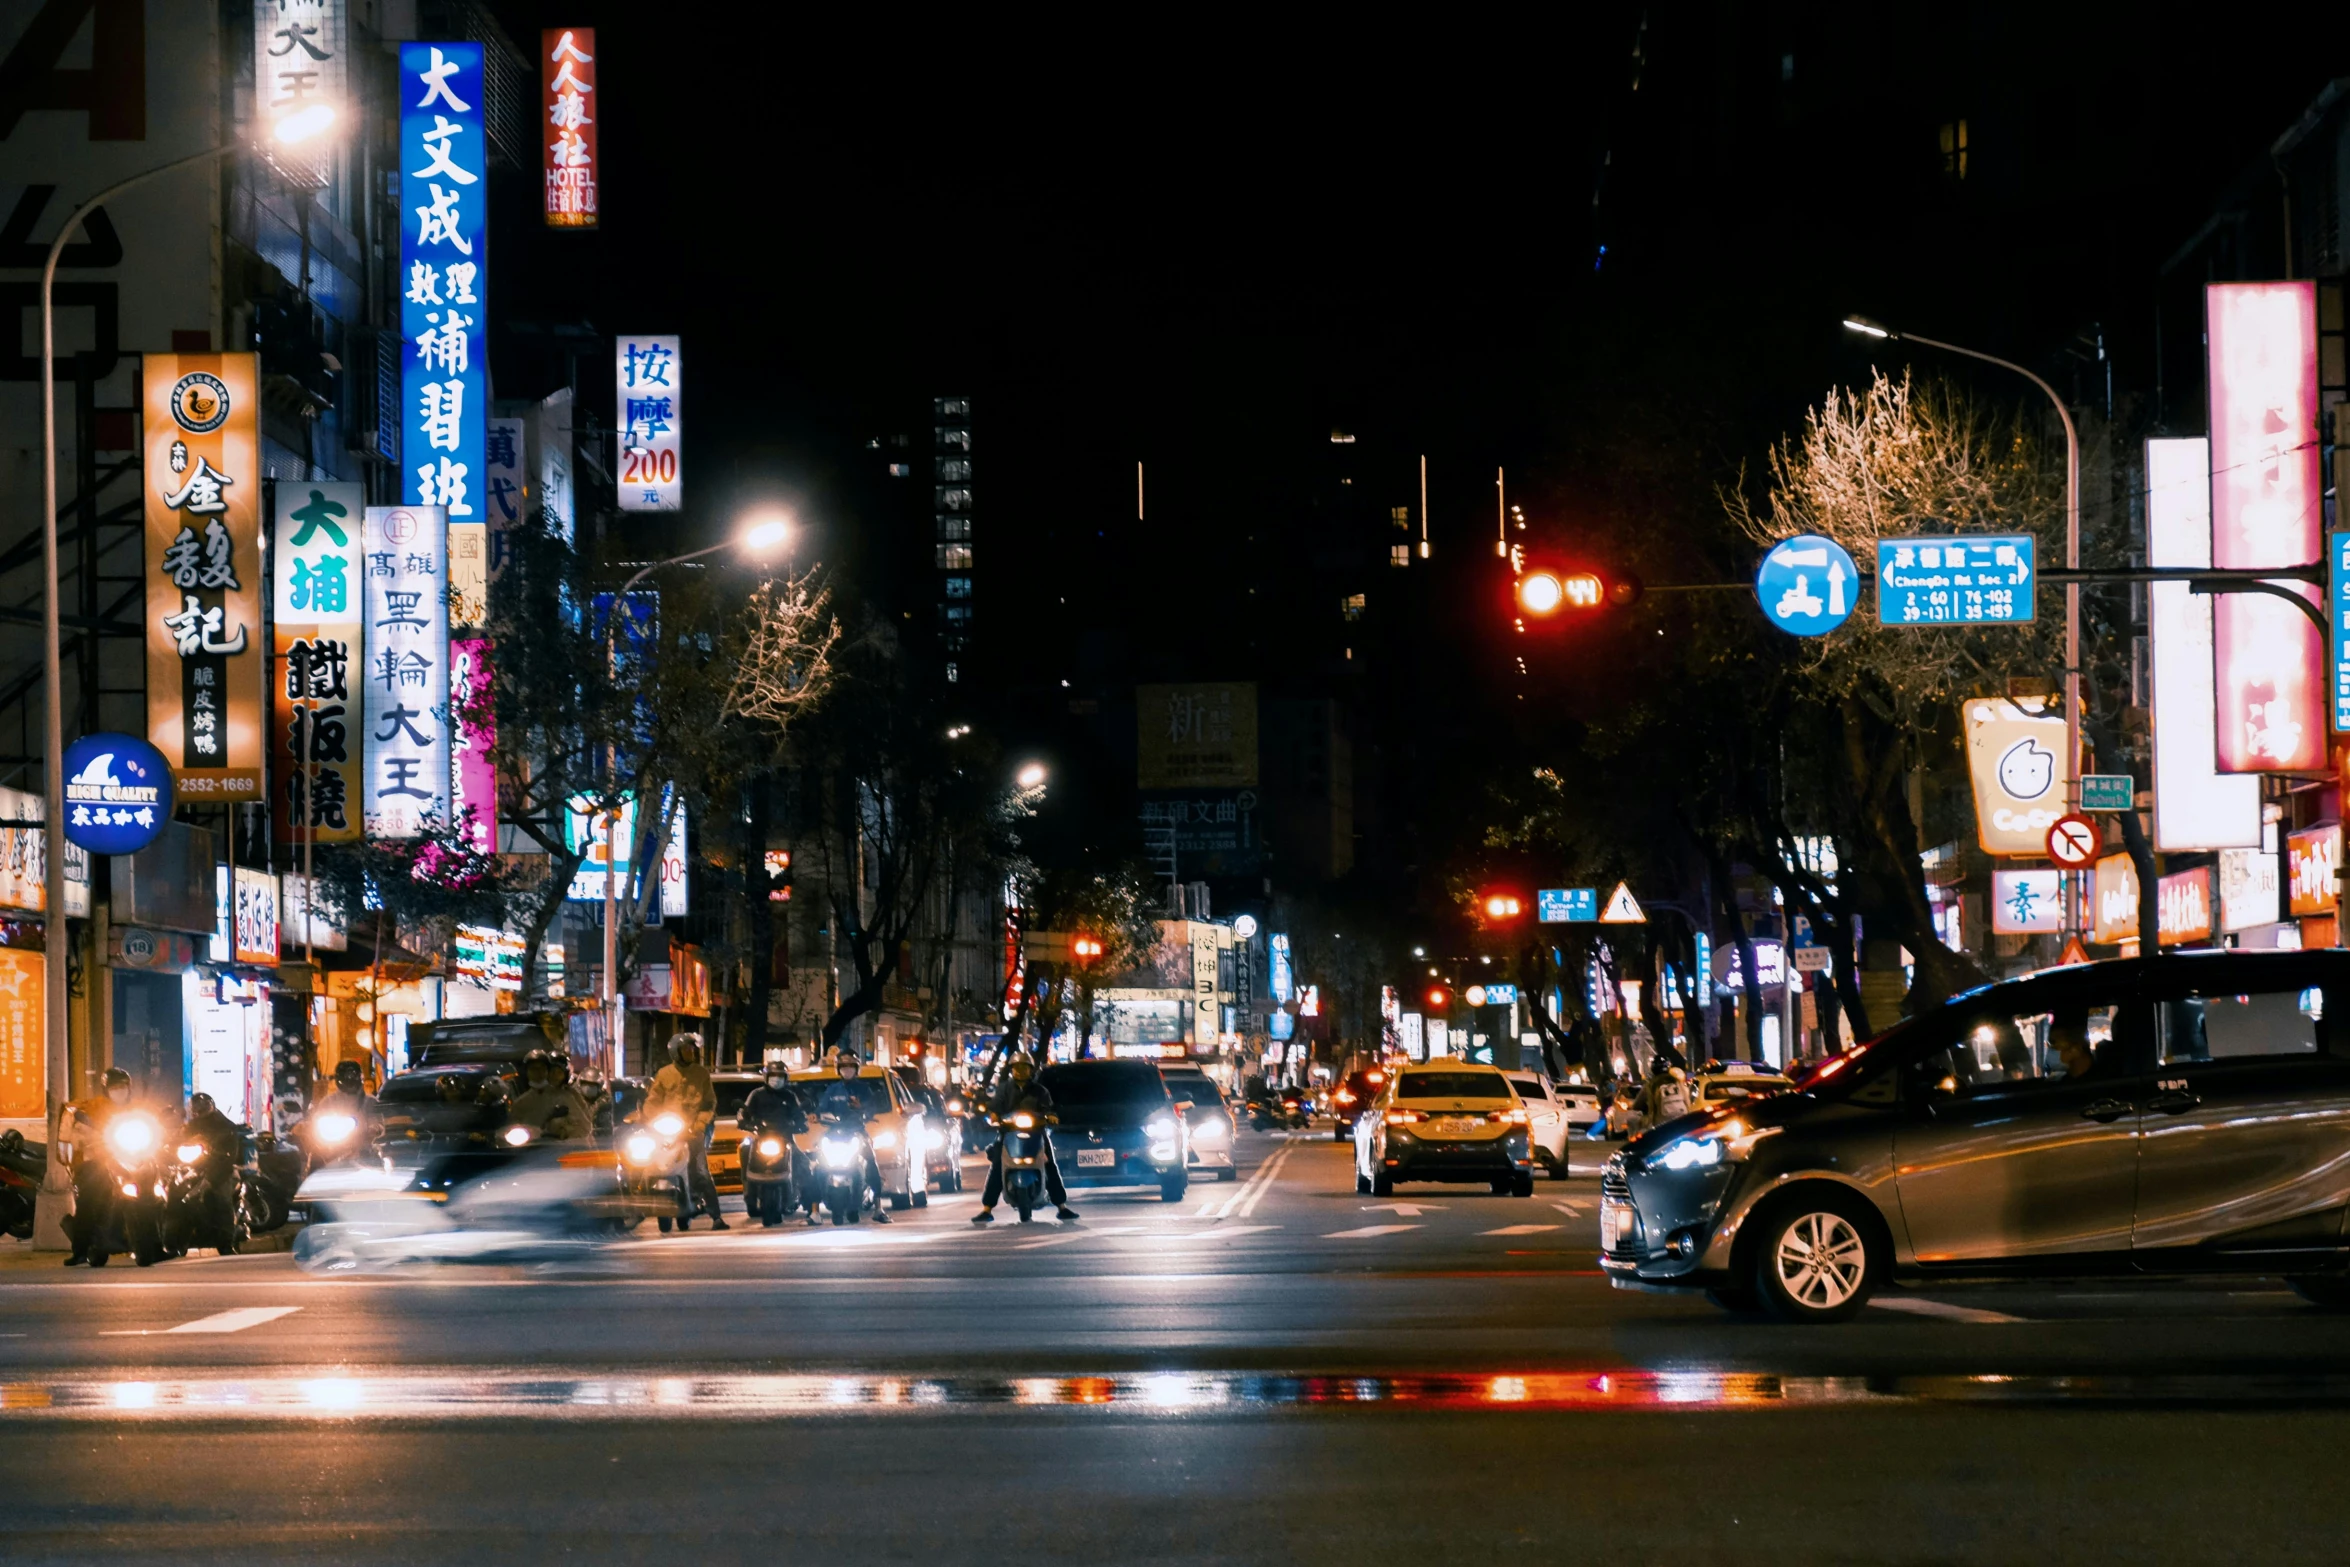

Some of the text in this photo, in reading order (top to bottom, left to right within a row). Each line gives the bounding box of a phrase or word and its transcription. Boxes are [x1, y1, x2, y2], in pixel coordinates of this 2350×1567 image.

[267, 0, 334, 108] 大王
[549, 31, 593, 167] 人人旅社
[411, 46, 480, 256] 大文成
[547, 168, 595, 186] HOTEL
[416, 308, 474, 517] 補習班
[623, 343, 674, 441] 按摩
[171, 442, 187, 471] 士林
[623, 448, 676, 484] 200
[642, 489, 660, 503] 元
[163, 455, 247, 658] 金馥記
[289, 488, 349, 614] 大埔
[2008, 573, 2017, 585] 2
[192, 666, 218, 755] 脆皮烤鴨
[374, 588, 435, 800] 黑輪大王
[66, 785, 158, 802] HIGH QUALITY
[180, 777, 254, 792] 2552-1669
[1795, 916, 1811, 936] P
